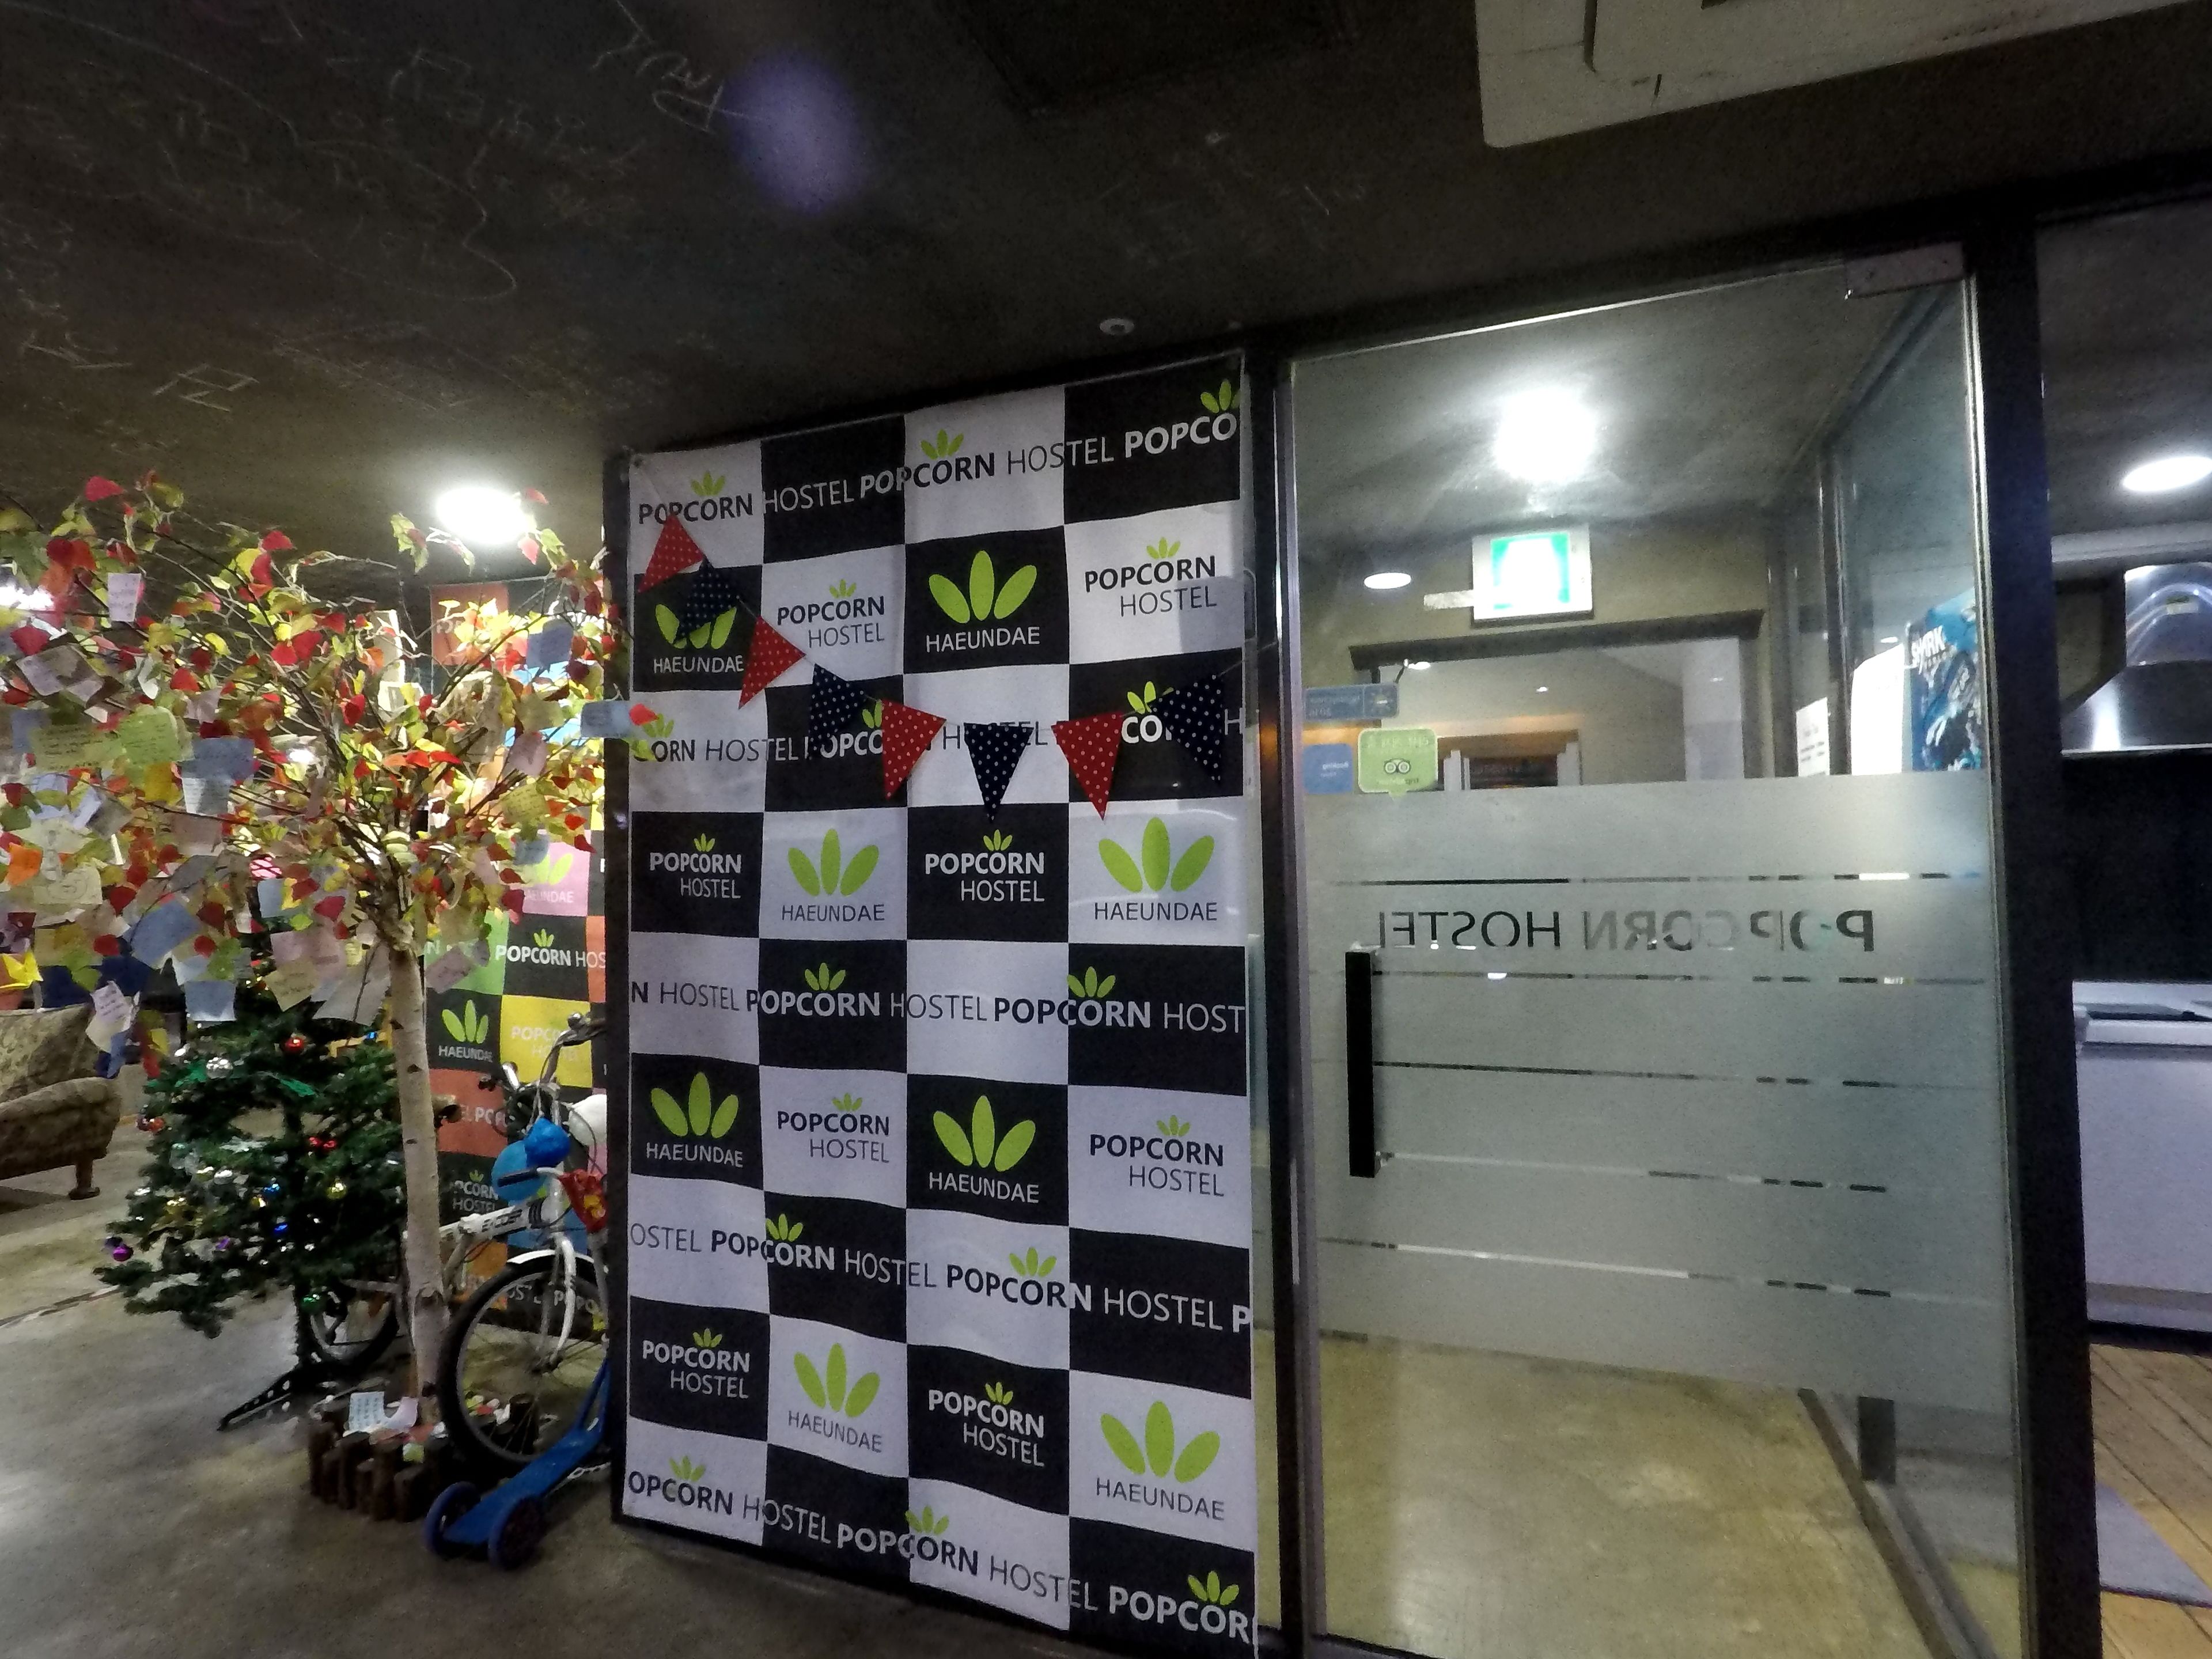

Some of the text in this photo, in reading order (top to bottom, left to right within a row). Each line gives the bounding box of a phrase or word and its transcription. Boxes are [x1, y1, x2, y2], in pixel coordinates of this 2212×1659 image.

[638, 412, 1237, 524] POPCORN HOSTEL POPCORN HOSTEL POPCO
[1085, 555, 1216, 592] POPCORN
[777, 595, 885, 626] POPCORN
[1120, 586, 1217, 616] HOSTEL
[808, 623, 885, 649] HOSTEL
[926, 627, 1040, 653] HAEUNDAE
[653, 655, 744, 674] HAEUNDAE
[705, 737, 798, 762] HOSTEL
[649, 852, 741, 874] POPCORN
[925, 851, 1044, 874] POPCORN
[680, 877, 741, 899] HOSTEL
[961, 880, 1045, 903] HOSTEL
[782, 903, 885, 922] HAEUNDAE
[1094, 902, 1218, 921] HAEUNDAE
[495, 945, 571, 967] POPCORN
[632, 981, 1245, 1033] N HOSTEL POPCORN HOSTEL POPCORN HOST
[778, 1111, 889, 1136] POPCORN
[646, 1142, 743, 1168] HAEUNDAE
[810, 1139, 890, 1163] HOSTEL
[1090, 1134, 1224, 1167] POPCORN
[929, 1172, 1039, 1203] HAEUNDAE
[1129, 1165, 1224, 1197] HOSTEL
[630, 1222, 1251, 1333] OSTEL POPCORN HOSTEL POPCORN HOSTEL P
[642, 1339, 750, 1373] POPCORN
[671, 1369, 749, 1399] HOSTEL
[928, 1388, 1044, 1438] POPCORN
[788, 1410, 882, 1453] HAEUNDAE
[963, 1422, 1045, 1468] HOSTEL
[1096, 1476, 1225, 1521] HAEUNDAE
[628, 1471, 1250, 1645] OPCORN HOSTEL POPCORN HOSTEL POPCOR
